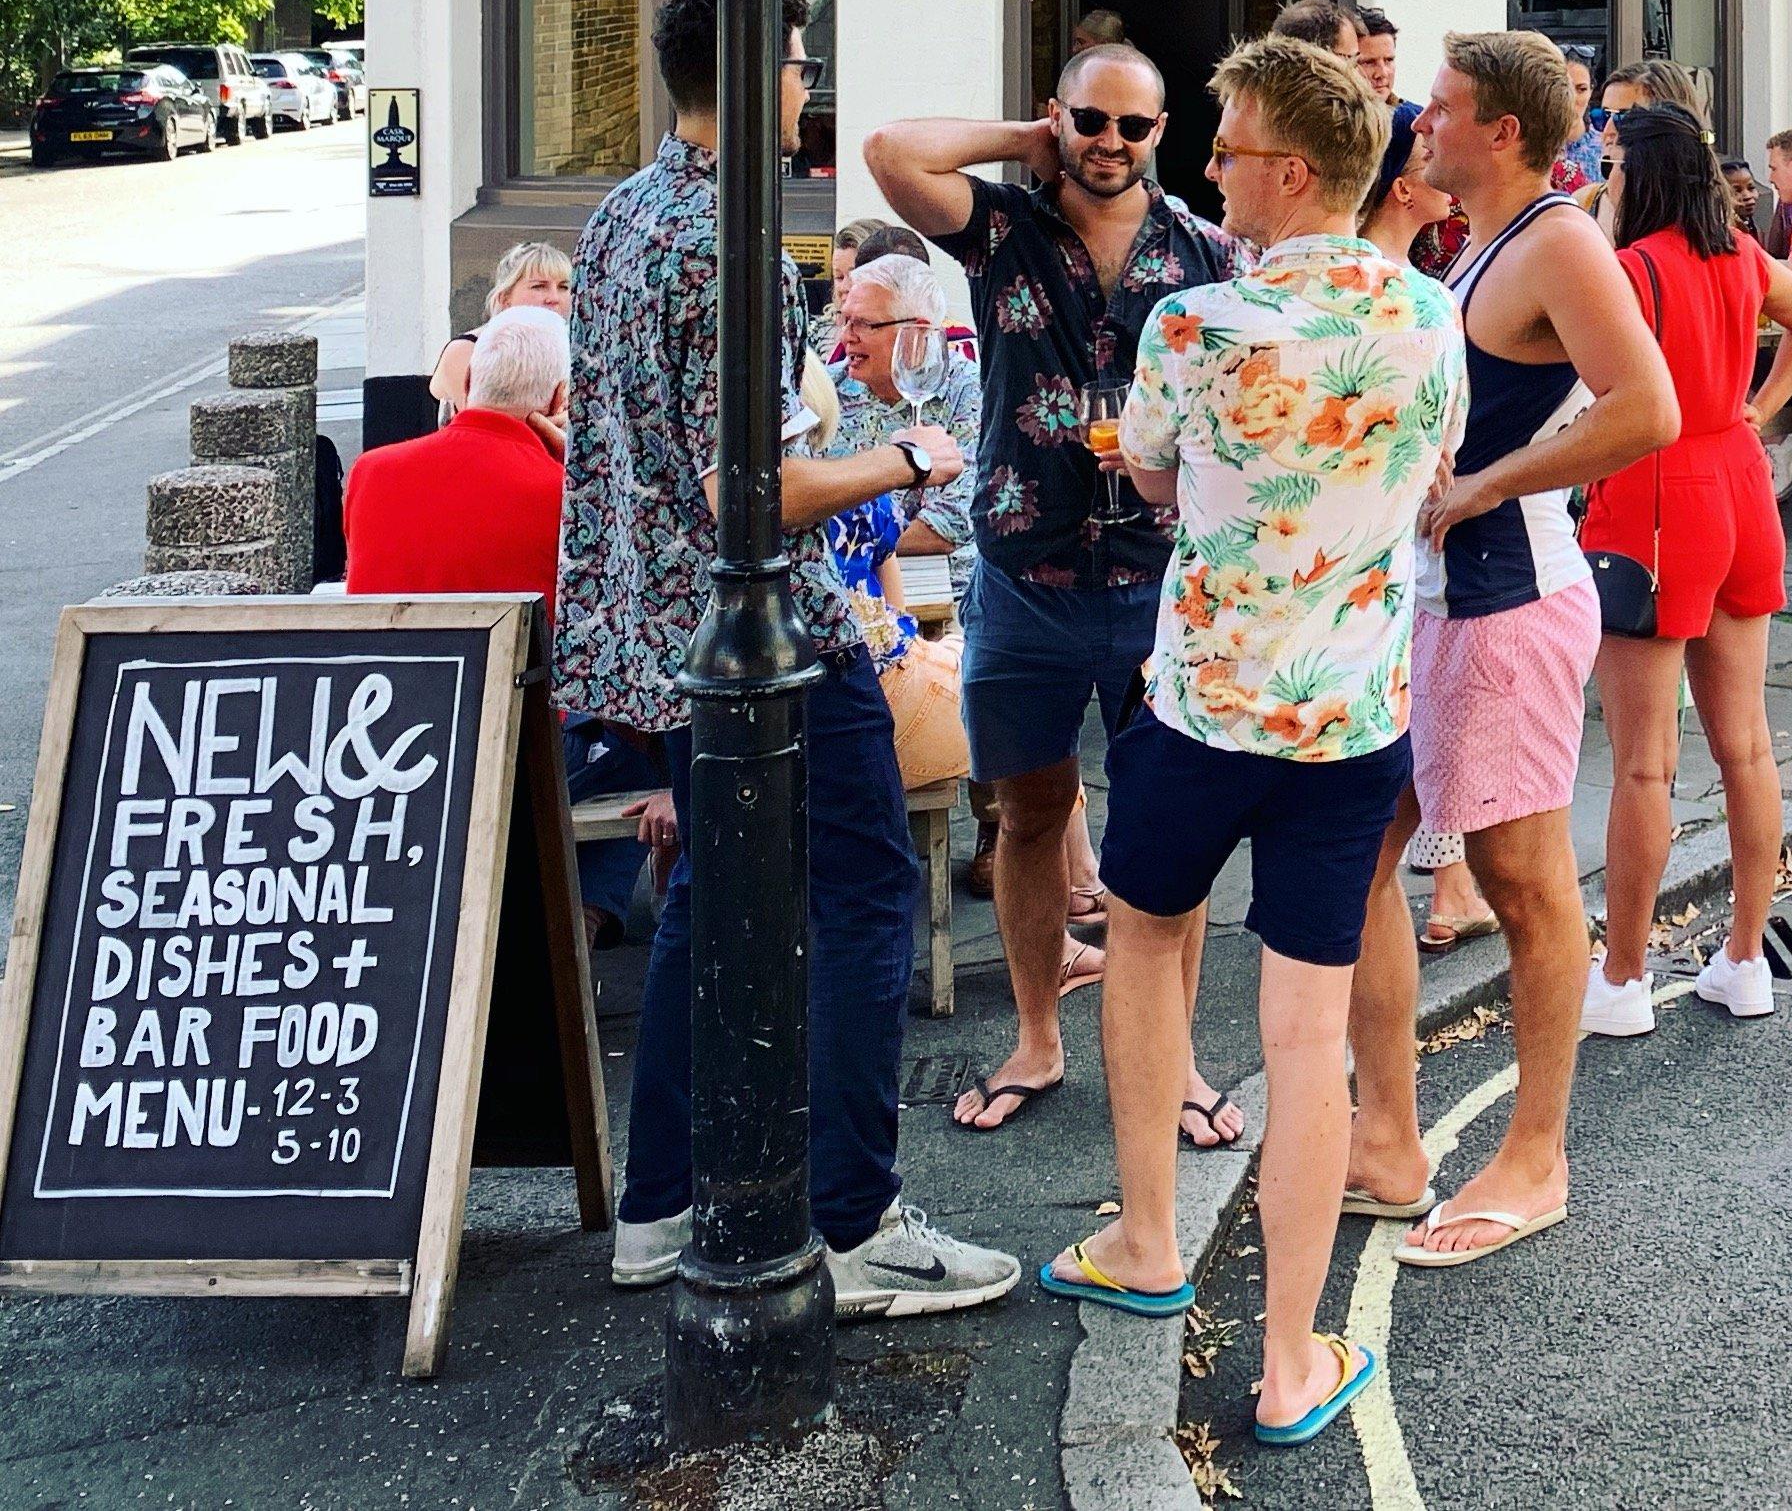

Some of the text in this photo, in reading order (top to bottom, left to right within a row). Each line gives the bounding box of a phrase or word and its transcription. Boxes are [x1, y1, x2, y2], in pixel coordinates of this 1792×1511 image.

[109, 793, 425, 868] FRESH,
[96, 863, 394, 930] SEASONAL
[91, 930, 378, 1002] DISHES +
[79, 1001, 379, 1069] BAR FOOD
